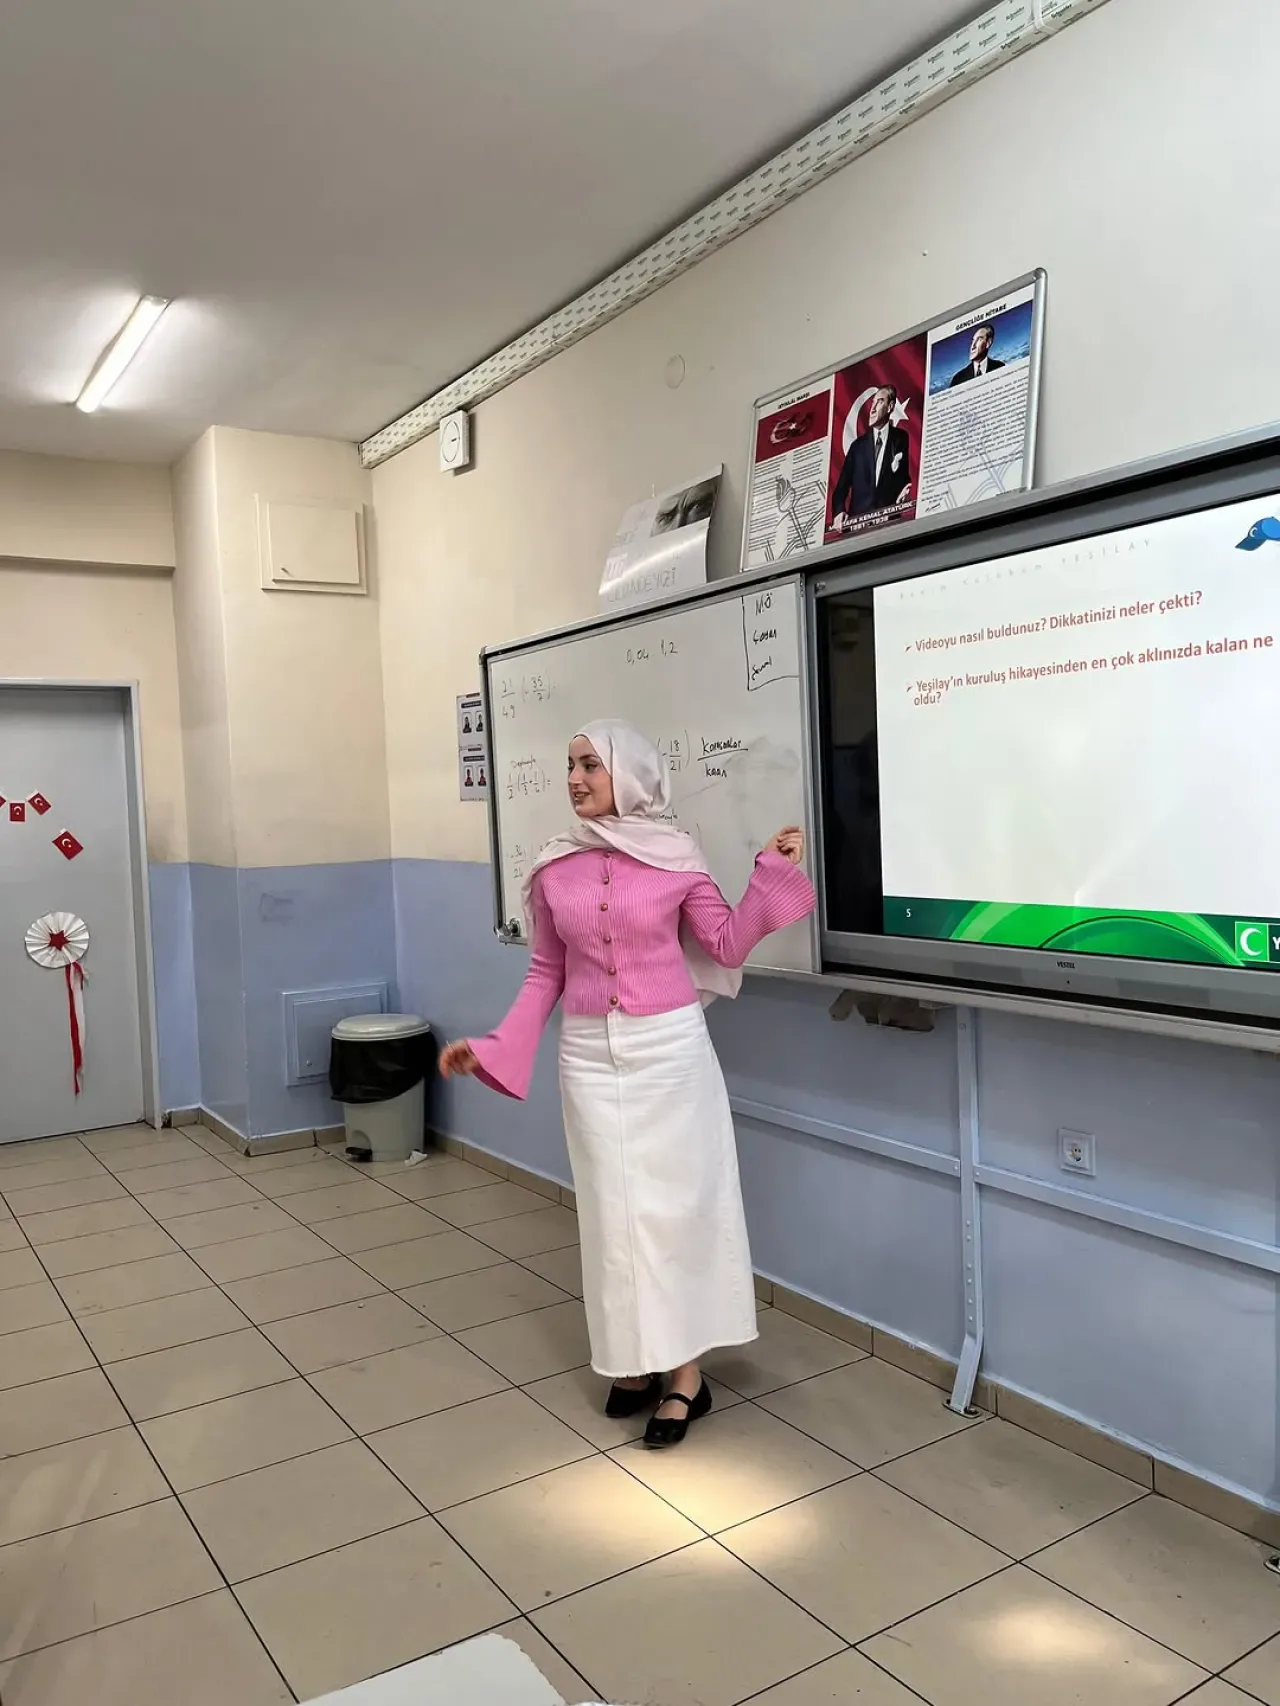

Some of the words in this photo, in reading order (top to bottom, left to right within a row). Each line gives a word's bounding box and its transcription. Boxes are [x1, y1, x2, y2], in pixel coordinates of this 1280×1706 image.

[915, 636, 957, 652] Videoyu
[959, 629, 984, 644] nasıl
[986, 618, 1047, 639] buldunuz?
[1049, 606, 1116, 629] Dikkatinizi
[1119, 601, 1155, 618] neler
[1159, 590, 1203, 614] çekti?
[965, 670, 1006, 686] kuruluş
[1009, 659, 1088, 681] hikayesinden
[1091, 656, 1107, 670] en
[1111, 651, 1134, 670] çok
[1138, 642, 1201, 664] aklınızda
[1205, 637, 1248, 655] kalan
[1253, 635, 1274, 649] ne
[914, 691, 942, 706] oldu?
